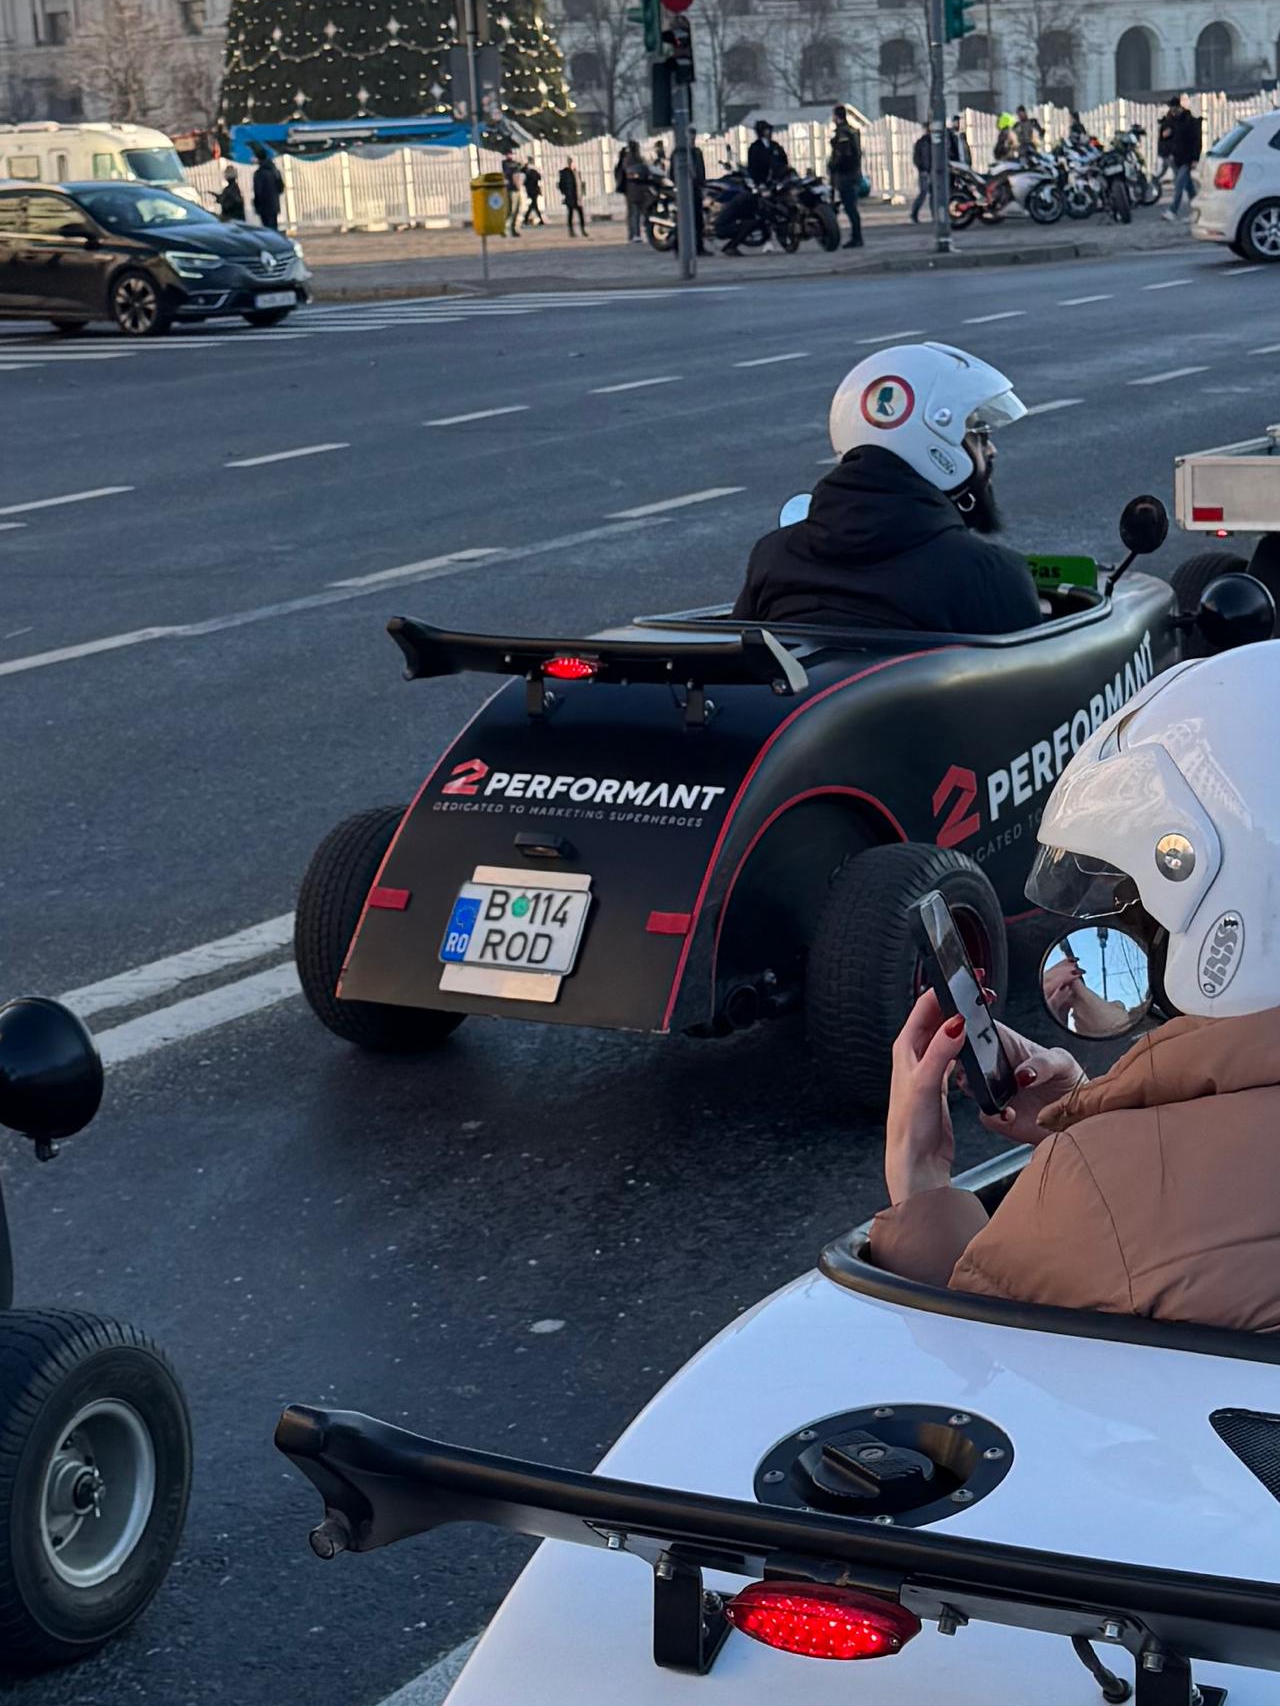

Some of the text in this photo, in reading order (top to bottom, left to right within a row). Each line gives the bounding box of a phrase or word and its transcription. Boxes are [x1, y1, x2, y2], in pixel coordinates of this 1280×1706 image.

[433, 801, 704, 828] DEDICATED TO MARKETING SUPERHEROES
[484, 889, 572, 928] B 114
[445, 932, 469, 954] RO
[479, 929, 553, 964] ROD
